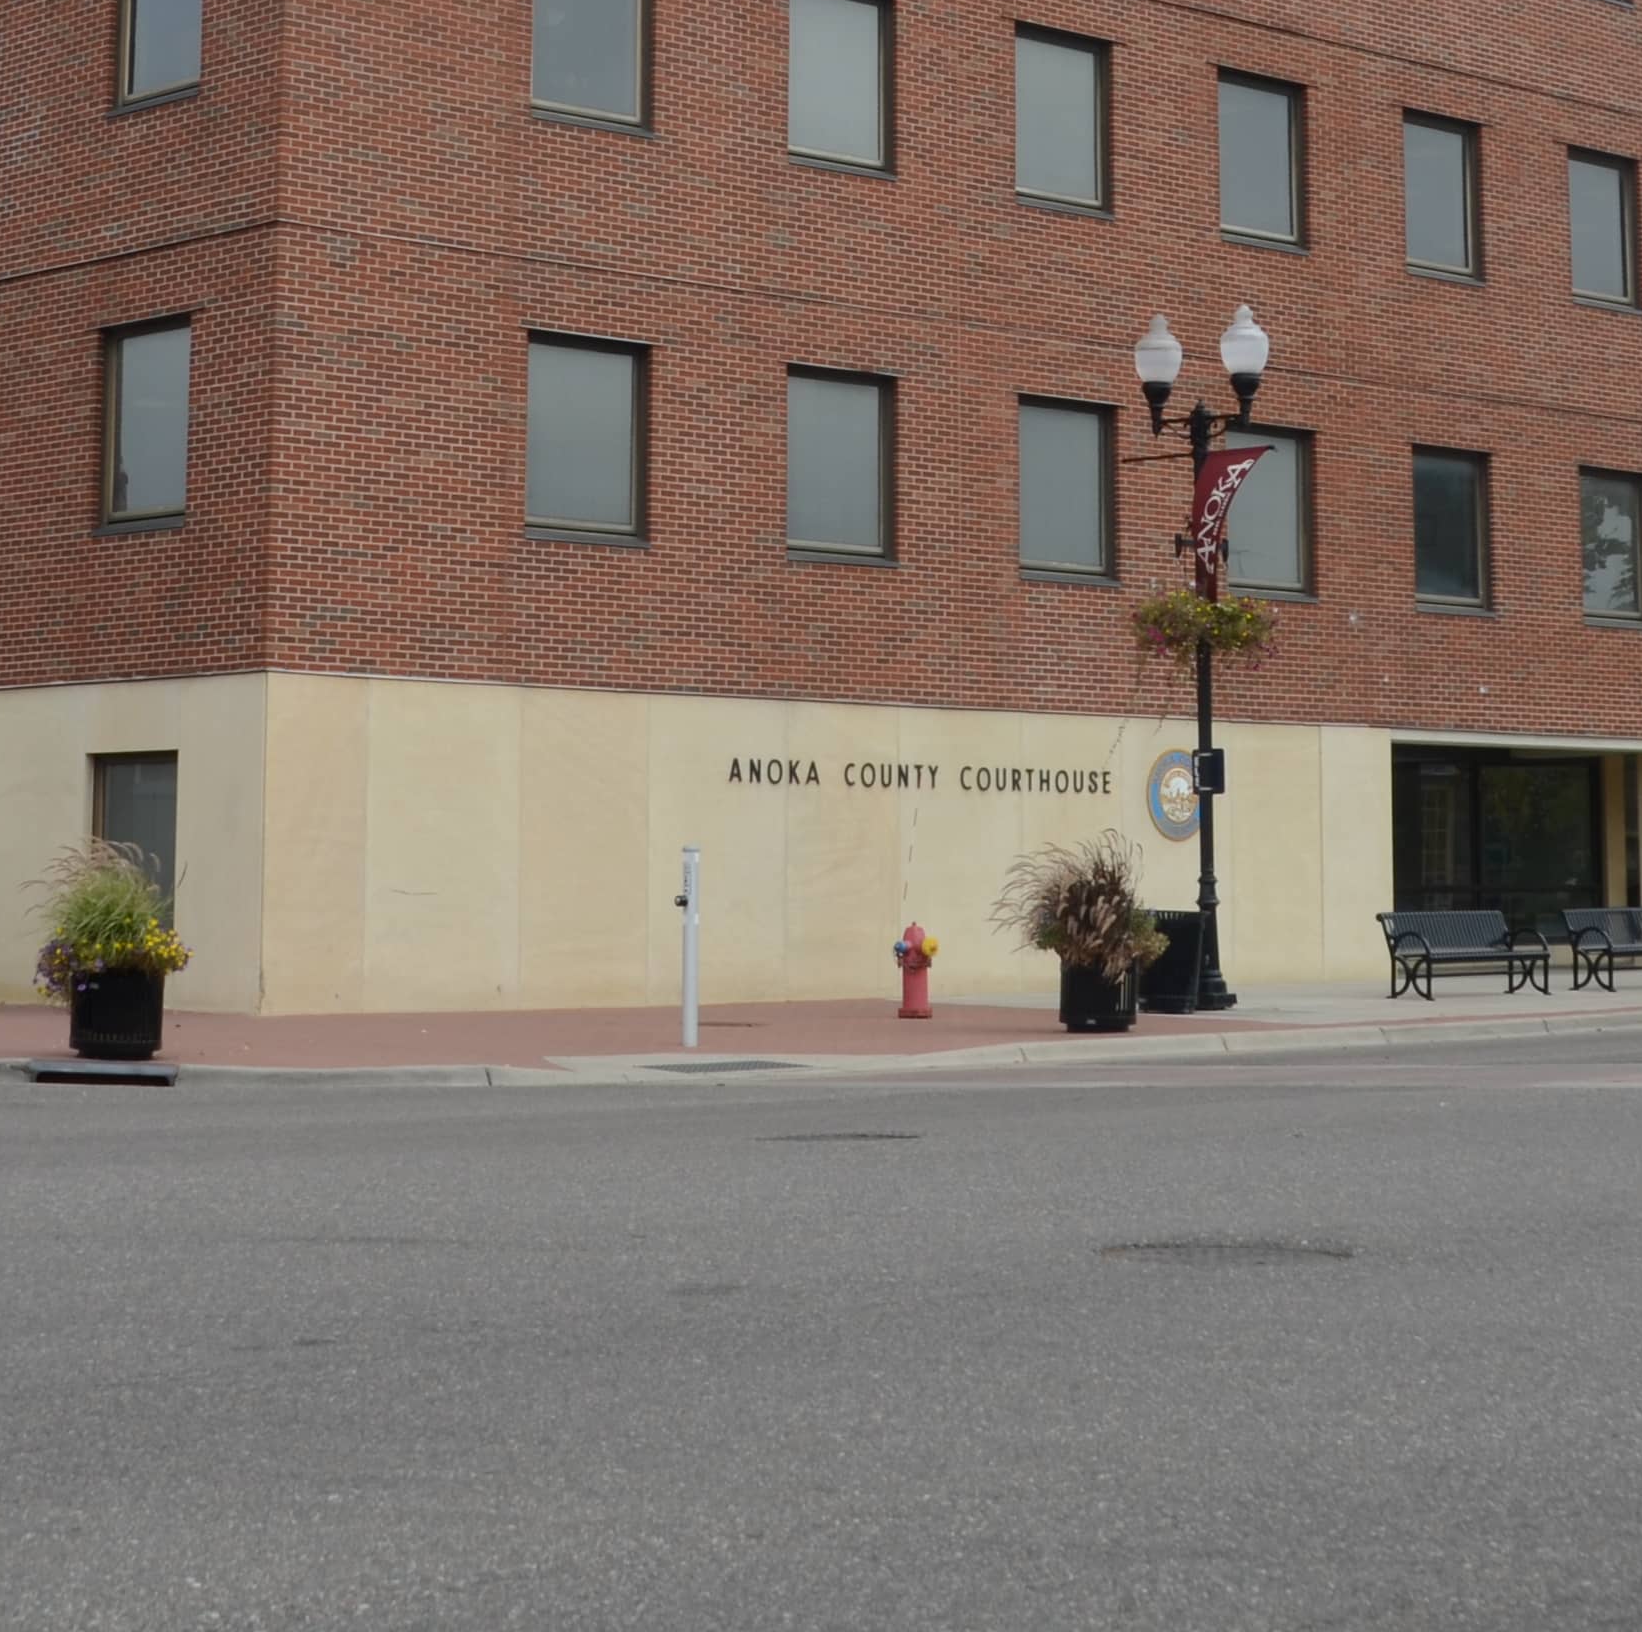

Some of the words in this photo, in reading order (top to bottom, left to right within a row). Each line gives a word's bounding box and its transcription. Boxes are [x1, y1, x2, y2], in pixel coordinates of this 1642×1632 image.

[1196, 459, 1255, 575] ANOKA
[729, 758, 820, 785] ANOKA
[844, 763, 939, 789] COUNTY
[960, 766, 1112, 795] COURTHOUSE
